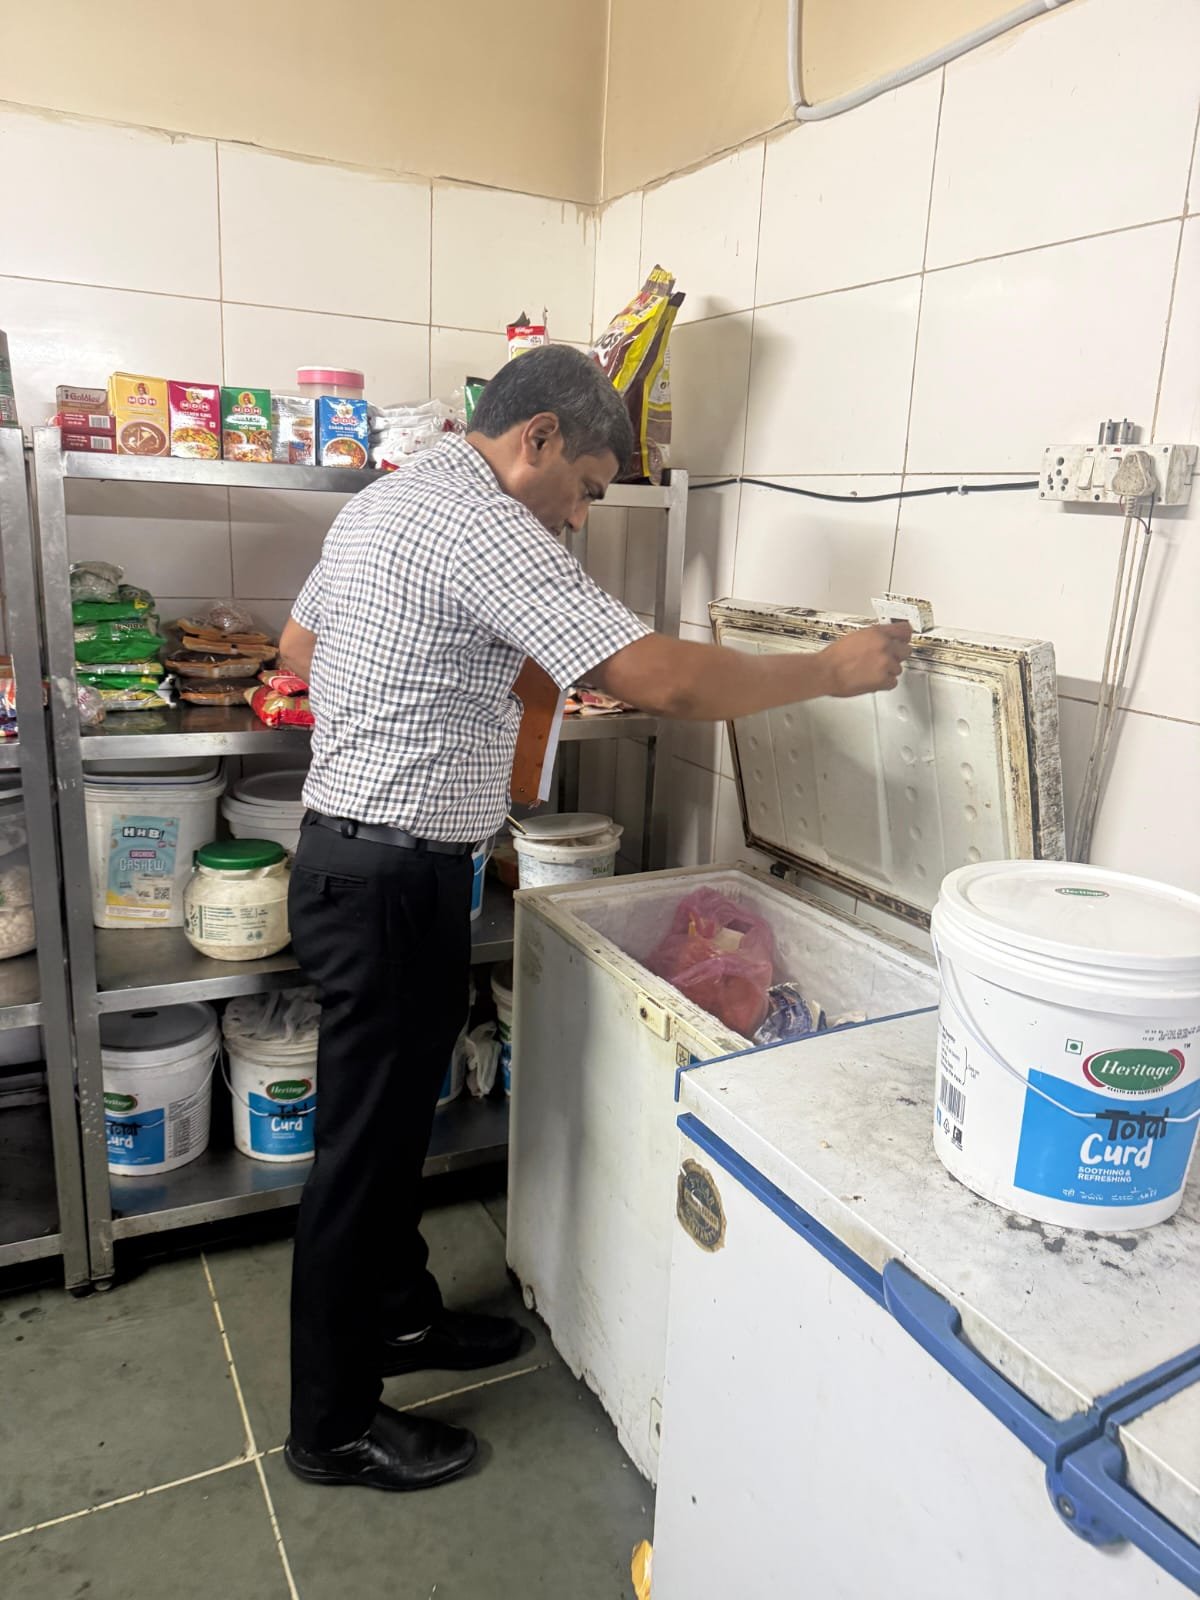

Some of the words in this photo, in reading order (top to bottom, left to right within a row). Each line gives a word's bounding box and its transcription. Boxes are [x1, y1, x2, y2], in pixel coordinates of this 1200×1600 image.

[119, 858, 165, 872] CASHEW
[1100, 1060, 1174, 1081] Heritage
[1106, 1086, 1126, 1096] HEALTH
[1137, 1087, 1164, 1096] HAPPINESS
[271, 1116, 304, 1132] Curd
[1105, 1107, 1170, 1141] Total
[107, 1135, 135, 1149] urd
[1079, 1132, 1154, 1169] Curd
[1077, 1173, 1132, 1183] REFRESHING
[1078, 1166, 1124, 1176] SOOTHING
